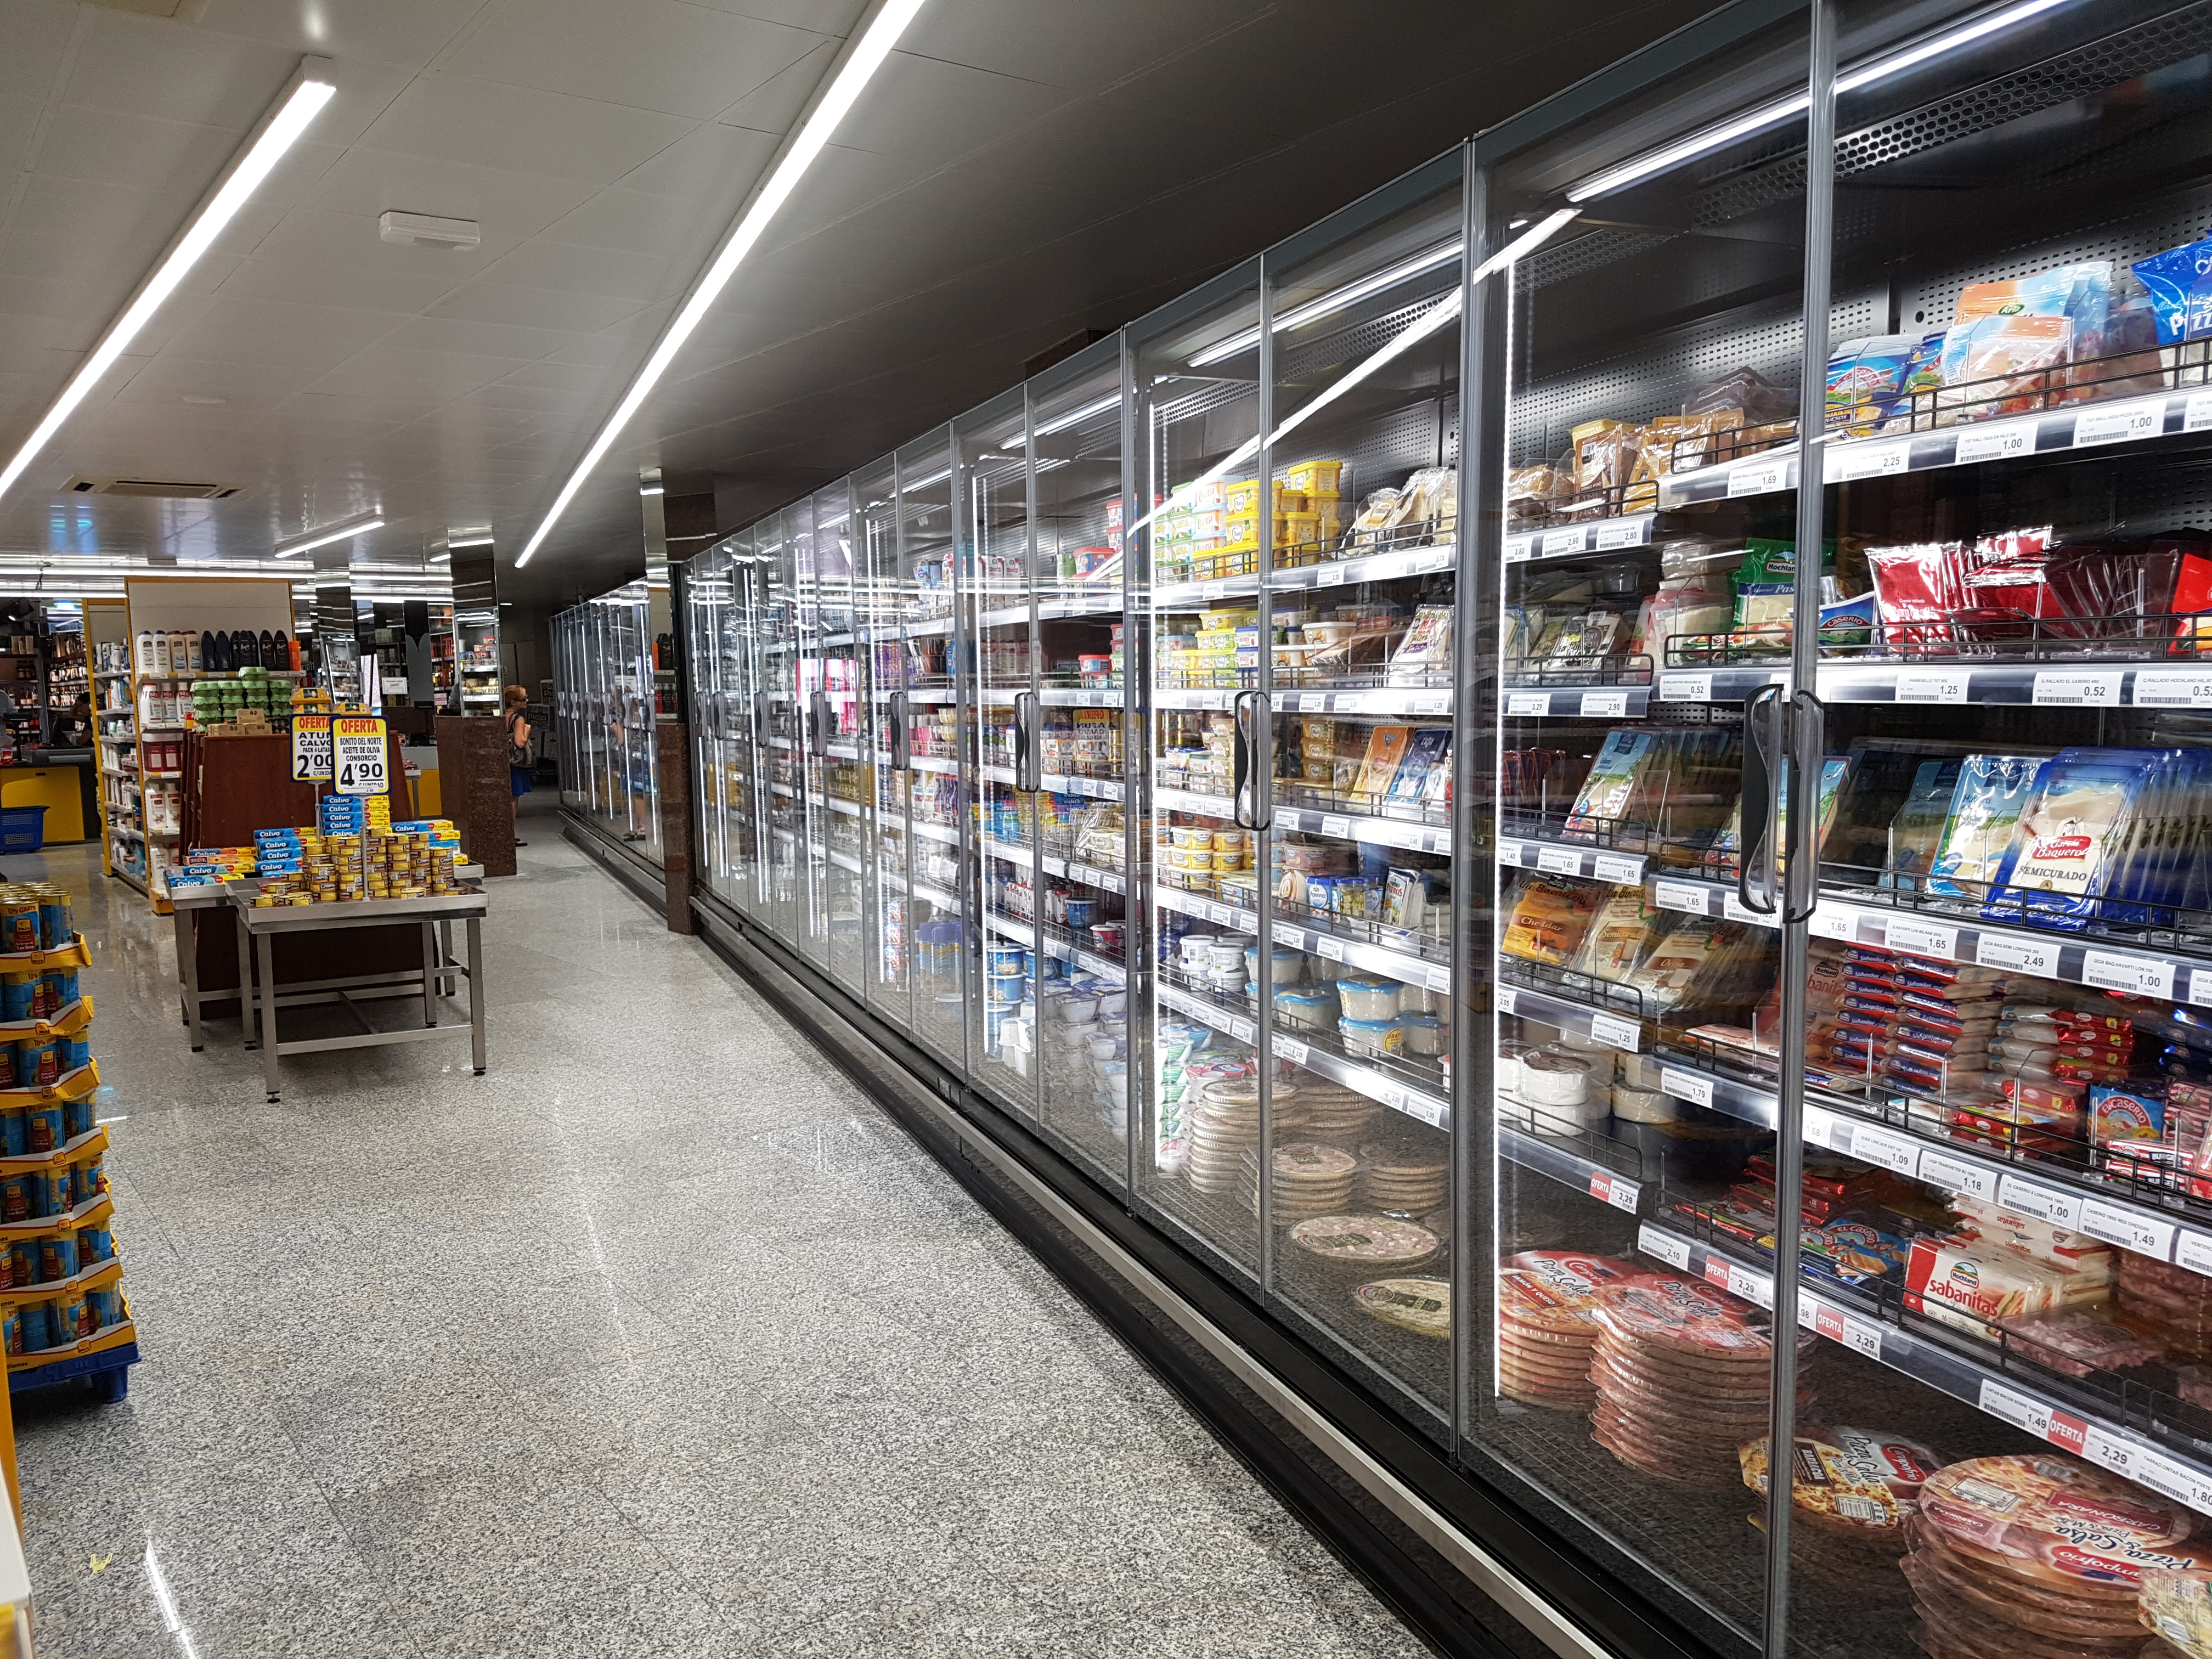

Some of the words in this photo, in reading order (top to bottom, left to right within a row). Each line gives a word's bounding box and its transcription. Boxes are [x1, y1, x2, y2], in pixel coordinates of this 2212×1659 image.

[2000, 305, 2020, 314] Arla
[2130, 416, 2152, 428] 1.00
[1883, 456, 1900, 467] 2.25
[1762, 475, 1776, 485] 1.69
[1768, 562, 1795, 572] Hochlan
[1775, 584, 1795, 594] Pas
[1690, 686, 1704, 694] 0,52
[1940, 685, 1958, 695] 1.25
[2084, 686, 2106, 697] 0,52
[341, 719, 378, 733] OFERTA
[340, 737, 357, 746] BONITO
[358, 737, 366, 746] DEL
[367, 737, 382, 745] NORTE
[2035, 847, 2083, 857] Baquero
[1623, 870, 1635, 878] 1.65
[2018, 865, 2087, 881] SEMICURADO
[1386, 884, 1403, 897] PATROS
[1519, 880, 1532, 890] La
[1606, 885, 1617, 899] La
[1686, 898, 1699, 906] 1.65
[1830, 922, 1847, 932] 1.65
[1928, 938, 1946, 949] 1.65
[1660, 958, 1685, 968] Oveja
[2023, 955, 2044, 967] 2.49
[1815, 967, 1838, 976] Hochland
[2138, 974, 2160, 987] 1.00
[1618, 1034, 1630, 1043] 1.25
[1692, 1088, 1705, 1098] 1.79
[2102, 1104, 2112, 1114] EL
[2111, 1098, 2147, 1124] CASERIO
[1892, 1153, 1909, 1165] 1.09
[1591, 1178, 1609, 1194] OFERTA
[1963, 1177, 1982, 1191] 1.18
[1619, 1192, 1633, 1204] 2,29
[2012, 1184, 2030, 1194] CASERIO
[2034, 1192, 2053, 1202] LONCHAS
[2049, 1204, 2068, 1218] 1.00
[2087, 1208, 2106, 1218] CASERIO
[1996, 1216, 2025, 1229] sabanitas
[1849, 1225, 1875, 1244] CASERIO
[2133, 1231, 2155, 1246] 1.49
[1667, 1249, 1680, 1260] 2.10
[1533, 1260, 1565, 1276] Pizza
[1706, 1262, 1728, 1280] OFERTA
[1953, 1271, 1977, 1286] Hochland
[1553, 1278, 1589, 1295] Salsa
[1738, 1280, 1754, 1293] 2,29
[1536, 1291, 1556, 1305] QUESO
[1928, 1279, 1999, 1317] sabanitas
[1817, 1314, 1842, 1334] OFERTA
[1856, 1334, 1875, 1349] 2,29
[1985, 1386, 2000, 1396] CINTAS
[2000, 1393, 2014, 1403] BACON
[2027, 1413, 2047, 1429] 1.49
[2050, 1420, 2084, 1446] OFERTA
[2102, 1446, 2128, 1465] 2,29
[2179, 1472, 2197, 1485] BACON
[2191, 1487, 2212, 1504] 1.80
[2058, 1500, 2160, 1531] CARBONARA
[2101, 1524, 2131, 1538] Pizza
[2053, 1526, 2118, 1550] Salsa
[2125, 1540, 2142, 1549] &
[2059, 1551, 2140, 1577] ampofrio
[2124, 1549, 2193, 1570] Pizza
